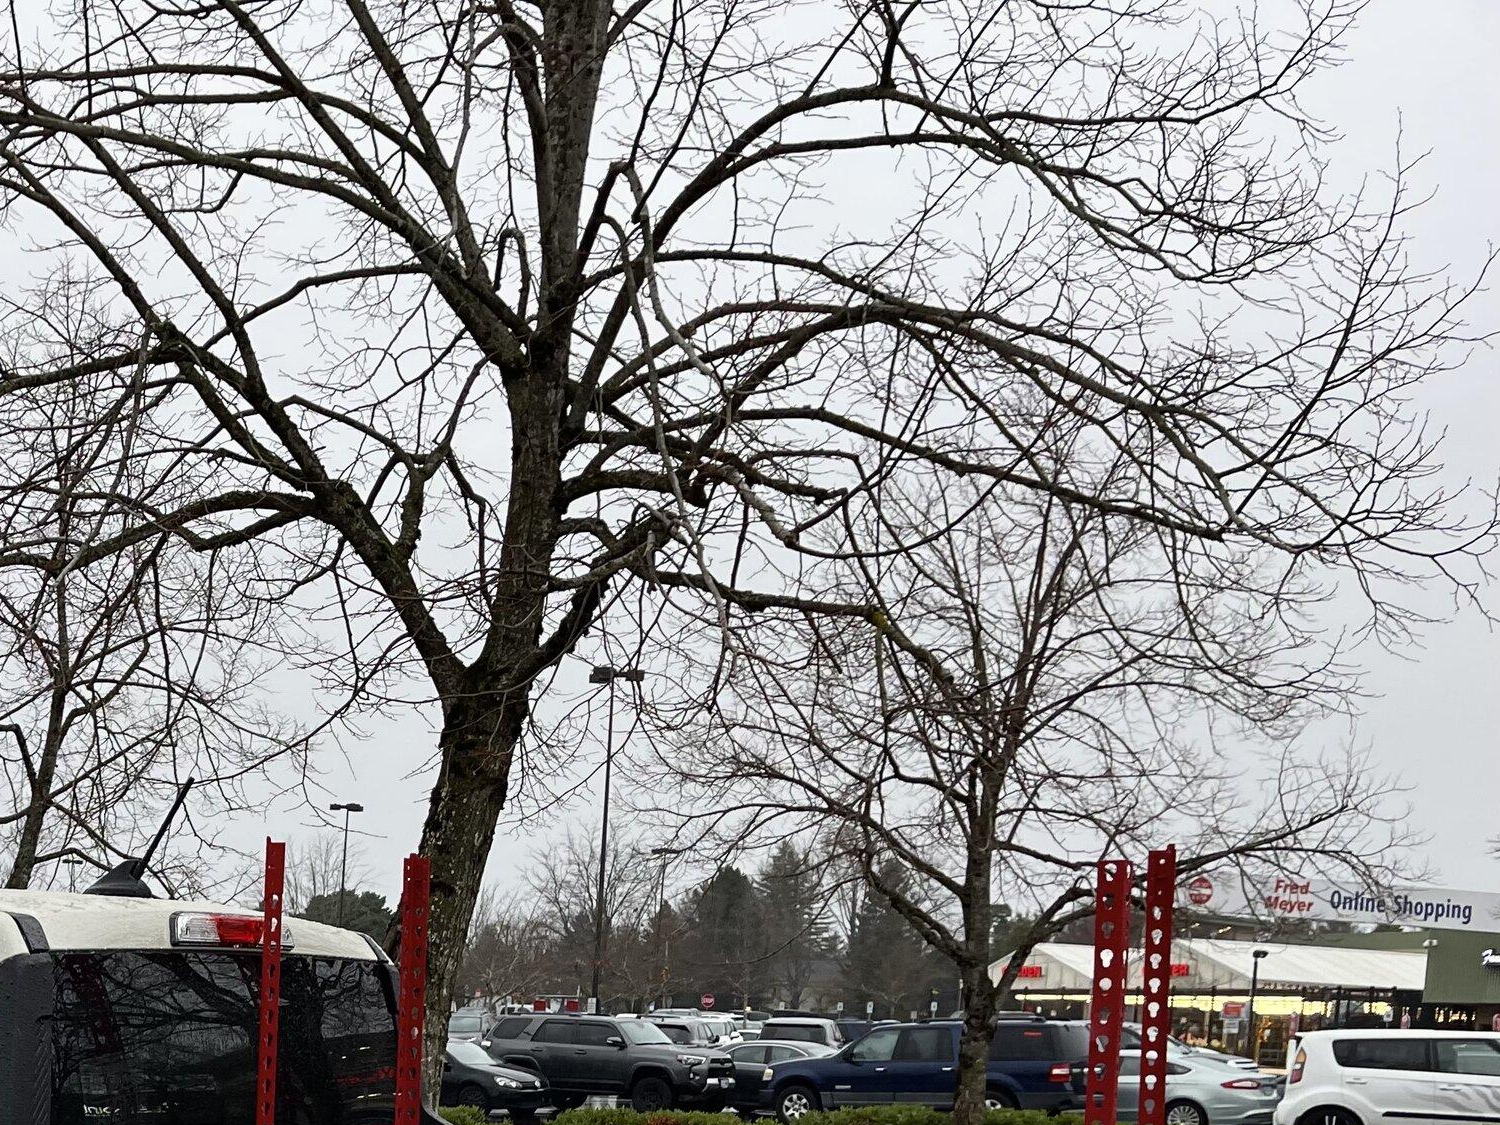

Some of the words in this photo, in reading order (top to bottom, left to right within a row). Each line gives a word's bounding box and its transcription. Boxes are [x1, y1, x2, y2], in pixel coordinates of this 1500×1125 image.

[1274, 879, 1310, 895] Fred
[1264, 897, 1314, 913] Meyer
[1330, 890, 1386, 913] Online
[1393, 895, 1473, 925] Shopping
